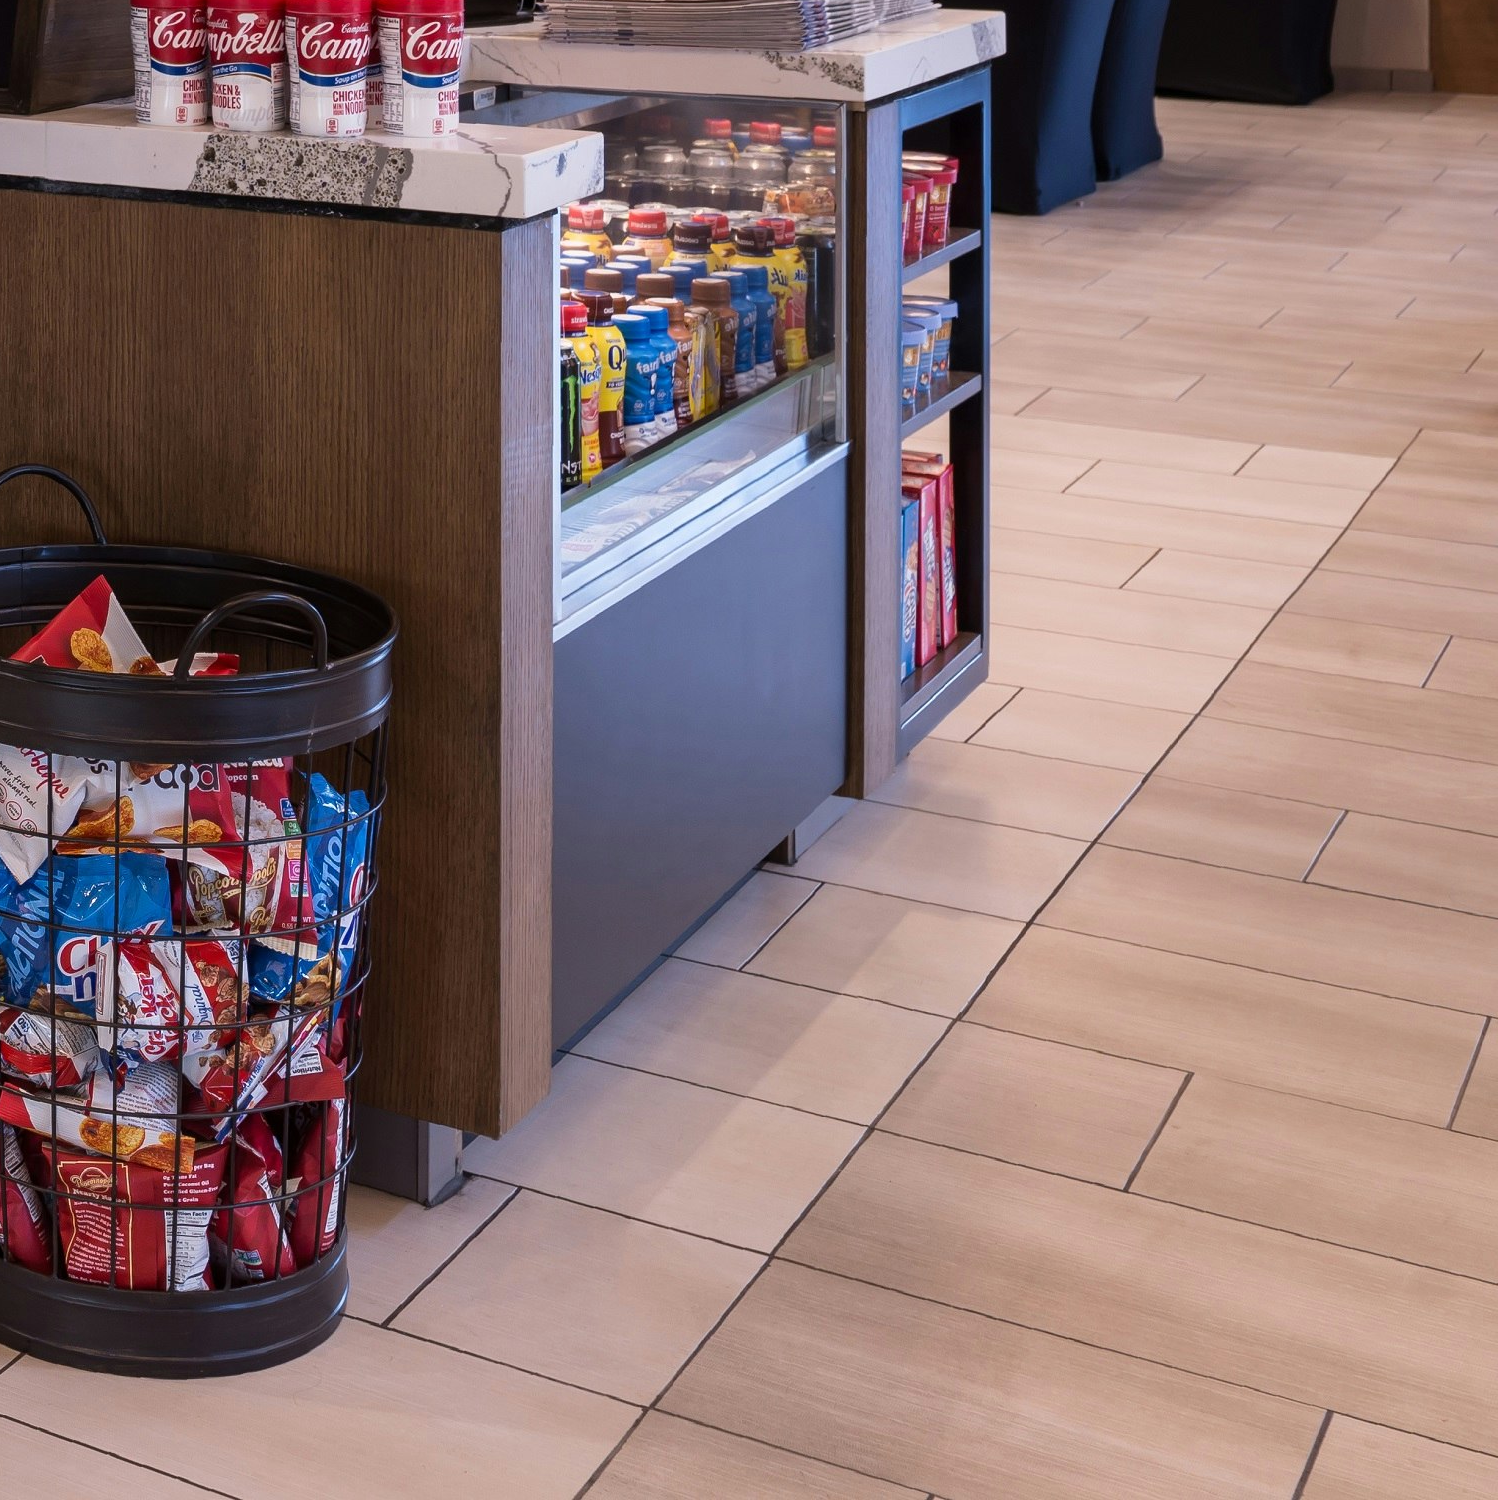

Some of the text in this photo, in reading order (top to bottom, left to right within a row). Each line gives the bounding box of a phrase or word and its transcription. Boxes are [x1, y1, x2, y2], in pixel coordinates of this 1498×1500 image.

[207, 13, 286, 61] mpbell's
[229, 65, 238, 73] Go
[334, 76, 350, 85] Soup
[234, 85, 241, 96] &
[18, 746, 71, 800] rbeque
[2, 775, 24, 798] always
[203, 1162, 215, 1170] Bag
